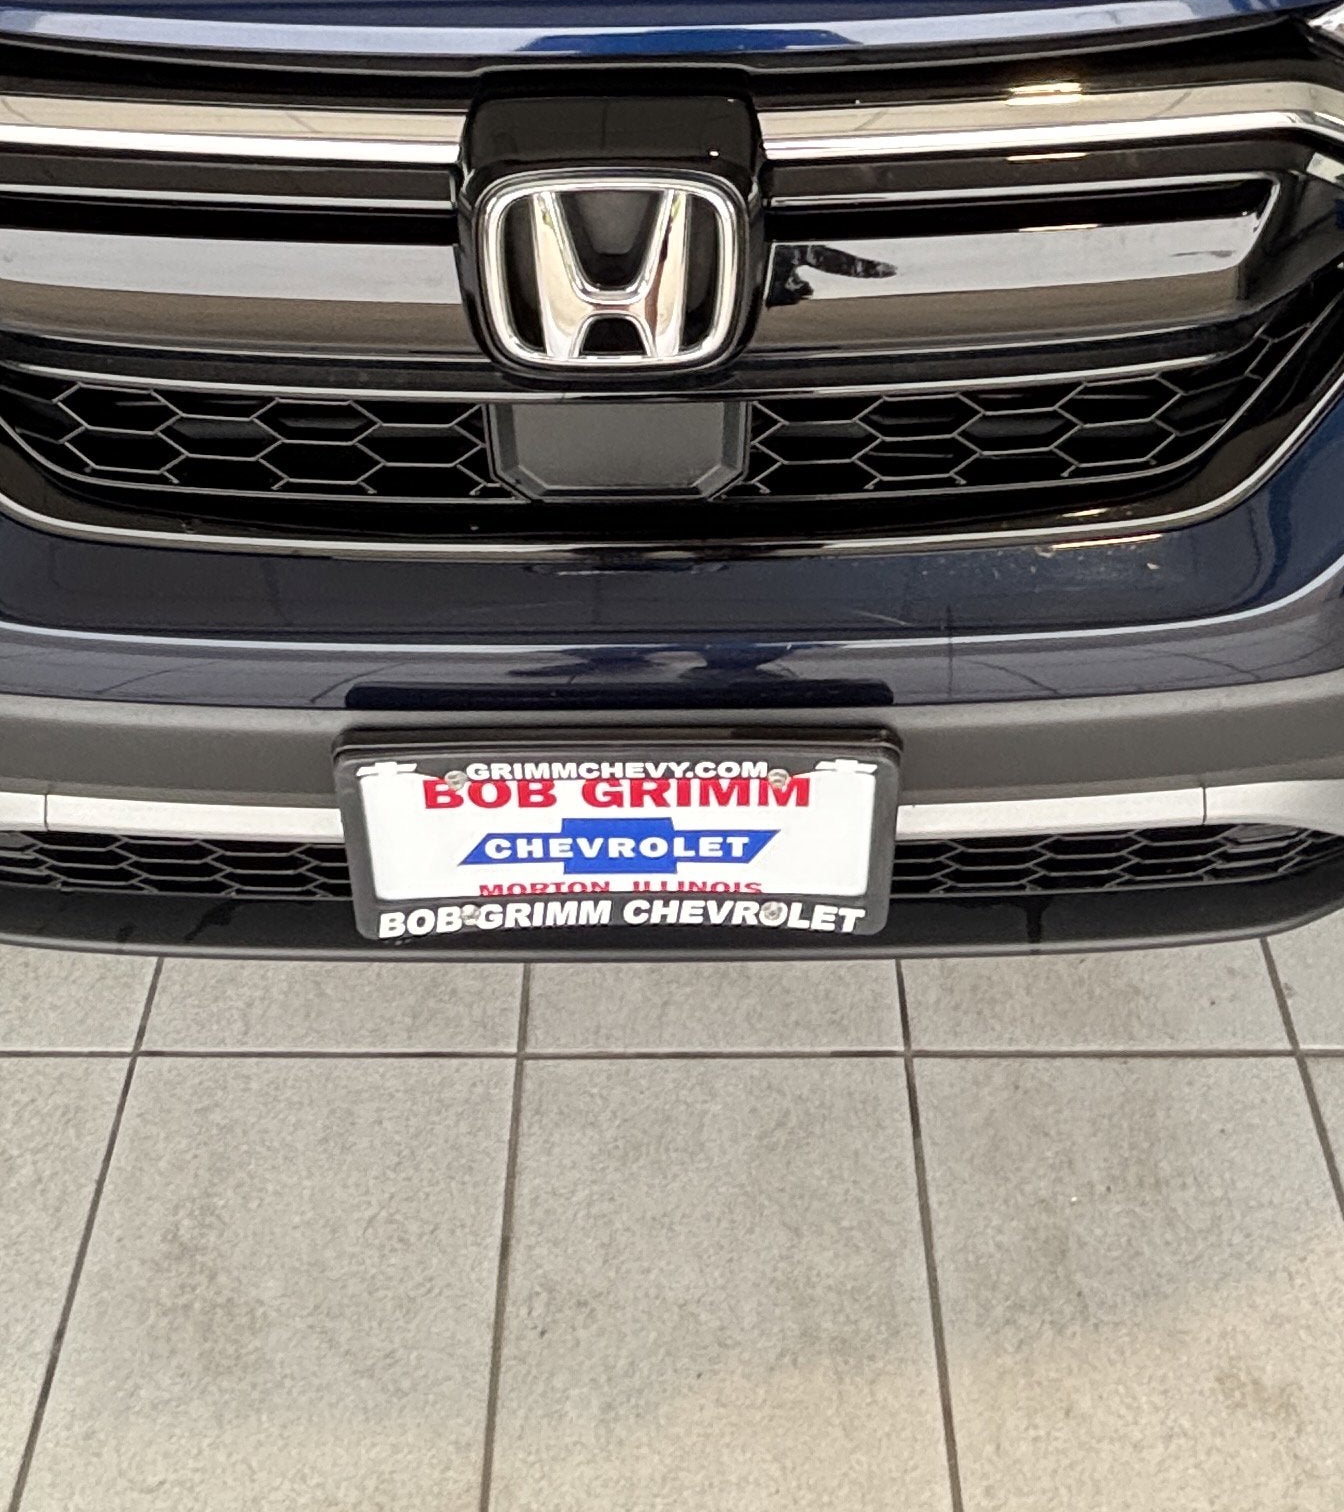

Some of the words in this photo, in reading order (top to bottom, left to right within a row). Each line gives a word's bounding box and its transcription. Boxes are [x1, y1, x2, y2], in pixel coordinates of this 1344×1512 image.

[466, 761, 768, 780] GRIMMCHEVY.COM
[423, 778, 557, 809] BOB
[582, 778, 810, 808] GRIMM
[485, 837, 749, 859] CHEVROLET
[479, 881, 610, 897] MORTON
[379, 906, 463, 938] BOB
[476, 900, 612, 930] GRIMM
[623, 899, 866, 933] CHEVROLET
